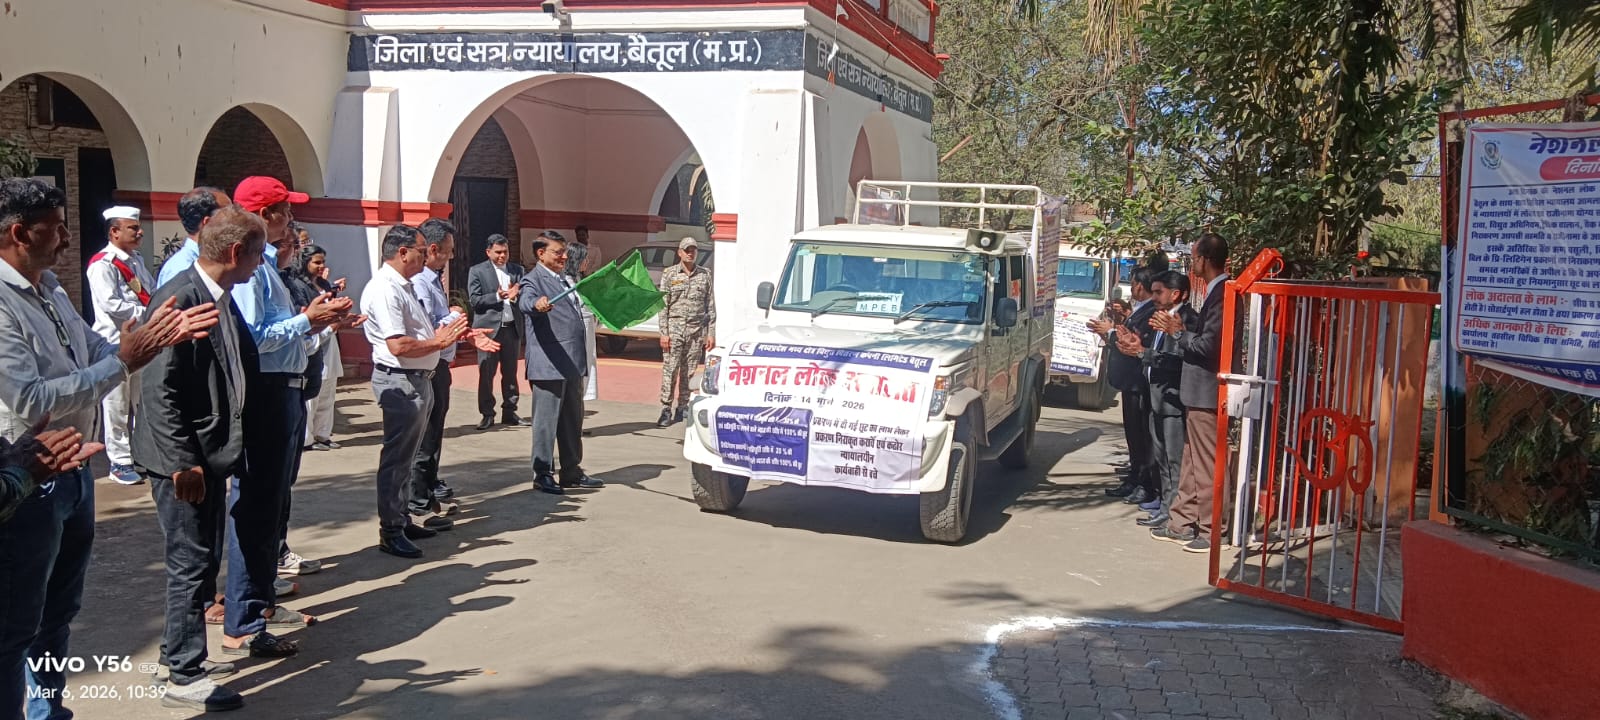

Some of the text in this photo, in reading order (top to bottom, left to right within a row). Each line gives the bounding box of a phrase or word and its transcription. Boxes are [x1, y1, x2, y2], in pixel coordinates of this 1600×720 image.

[373, 35, 427, 63] जिला
[430, 36, 463, 63] एवं
[466, 42, 509, 63] सत्र
[1465, 288, 1486, 301] लोक
[1487, 291, 1523, 304] अदालत
[1524, 290, 1535, 304] के
[1536, 294, 1558, 306] लाभ
[1464, 317, 1490, 330] अधिक
[1492, 321, 1533, 334] जानकारी
[1534, 322, 1545, 334] के
[1546, 323, 1569, 337] लिए
[793, 361, 839, 387] लोक
[801, 395, 811, 404] 14
[842, 400, 865, 411] 2026
